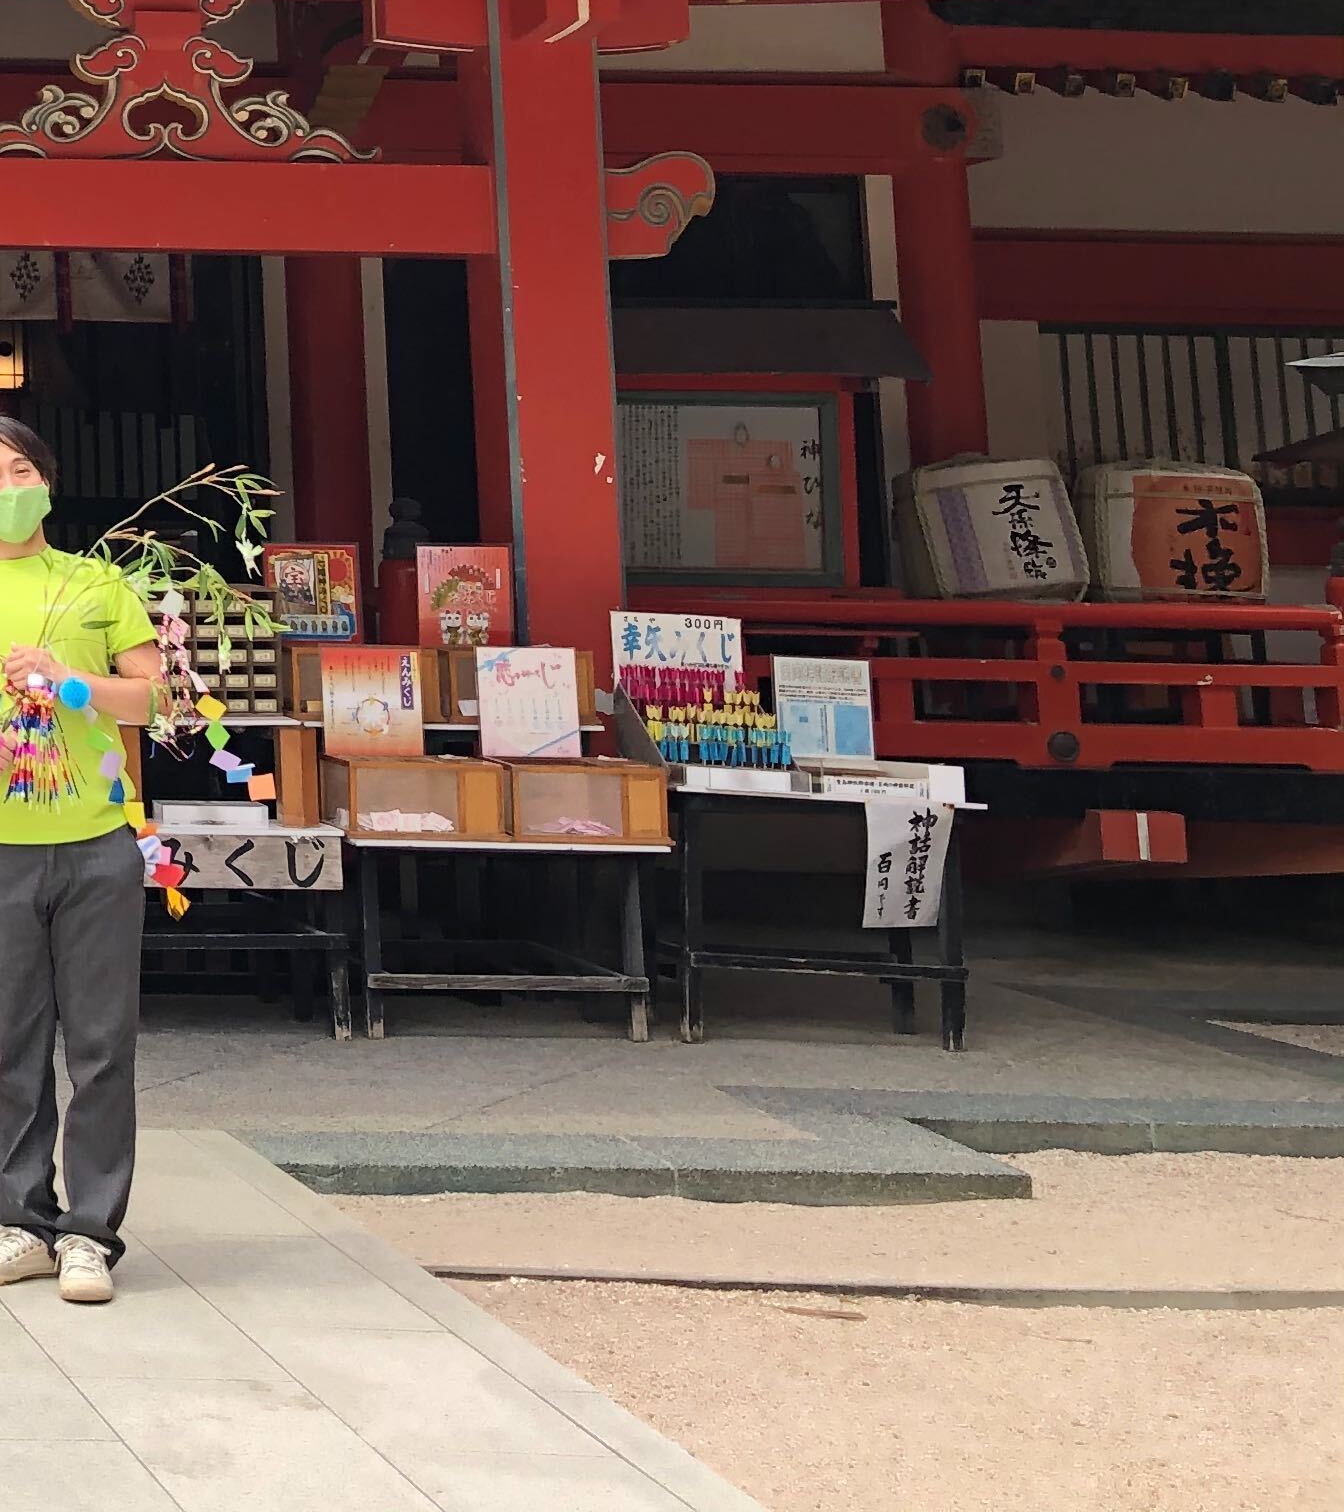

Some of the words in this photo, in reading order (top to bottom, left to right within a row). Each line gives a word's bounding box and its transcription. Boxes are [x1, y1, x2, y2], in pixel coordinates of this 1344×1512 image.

[684, 618, 723, 630] 300円
[400, 656, 412, 707] えんみくじ
[904, 807, 938, 920] 神話解説書
